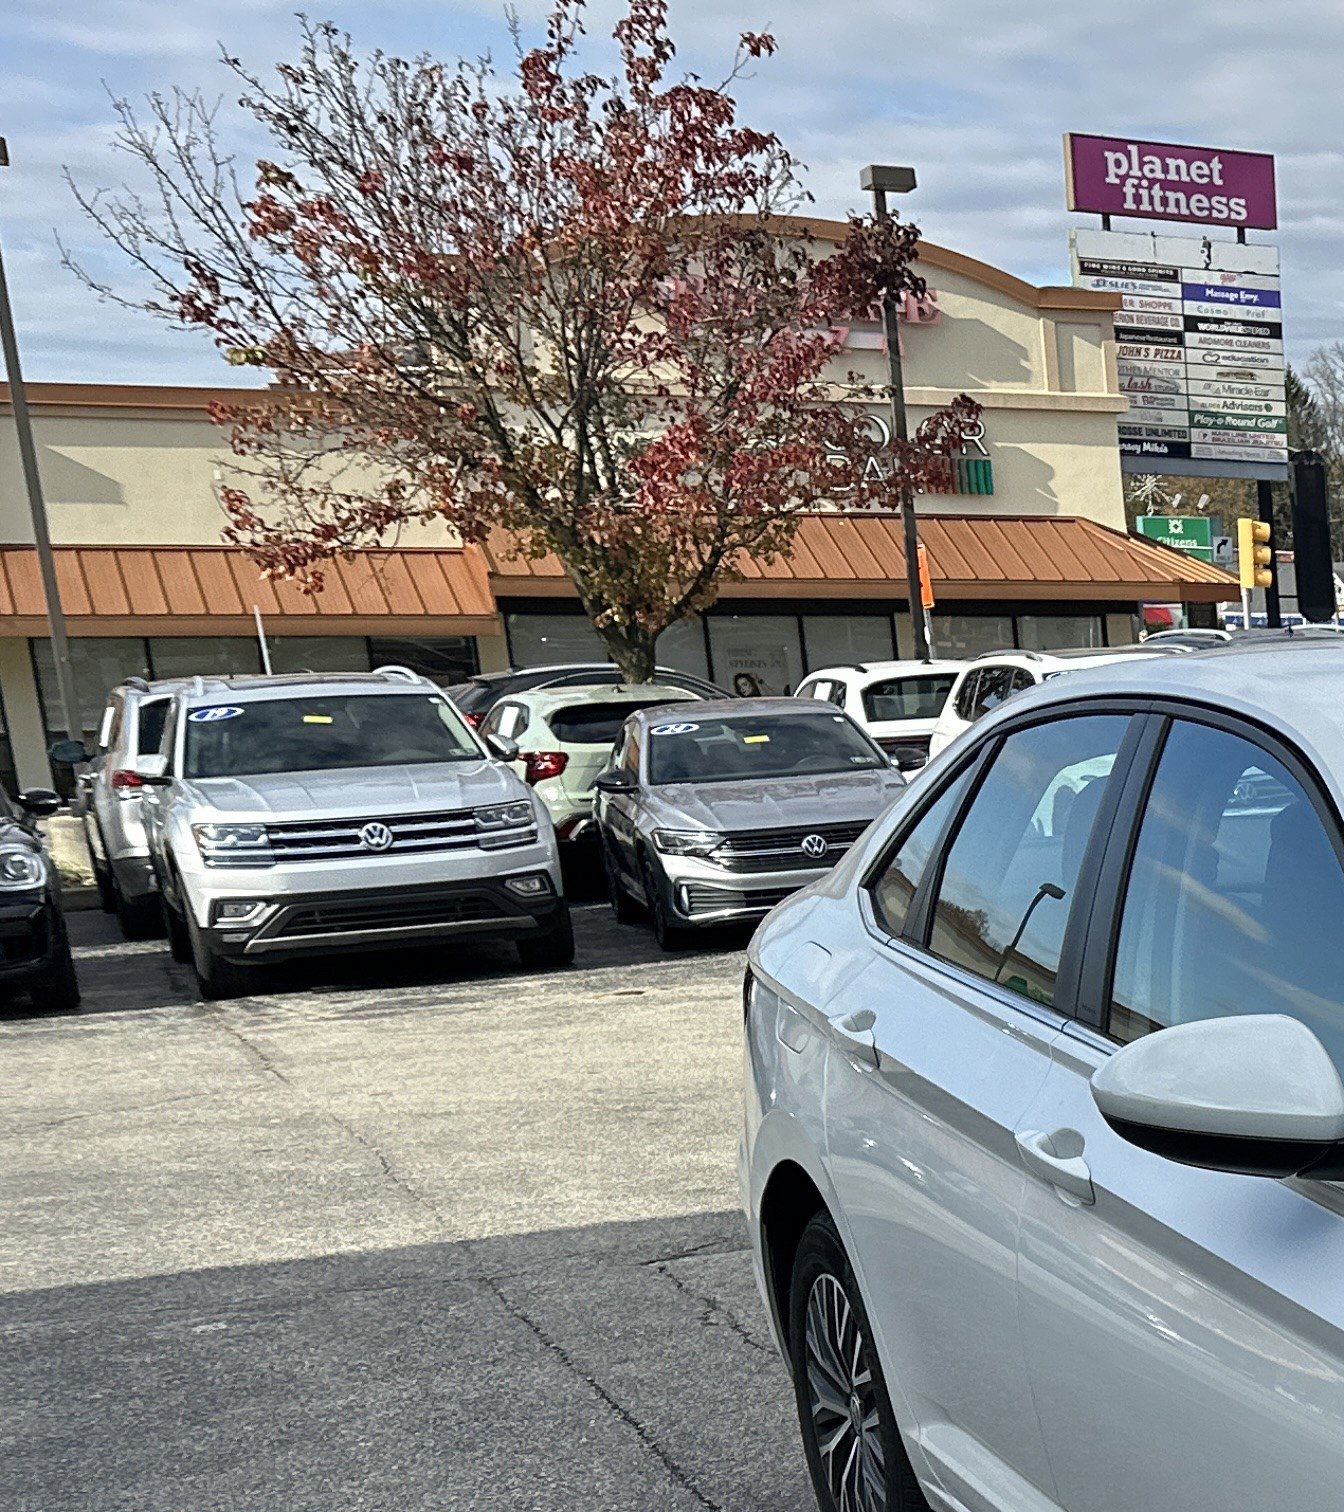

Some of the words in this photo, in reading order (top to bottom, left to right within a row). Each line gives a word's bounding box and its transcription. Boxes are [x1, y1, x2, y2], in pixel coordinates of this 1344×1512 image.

[1103, 144, 1224, 186] planet
[1122, 178, 1248, 221] fitness
[1205, 288, 1239, 301] Massage
[1139, 300, 1173, 311] SHOPPE
[1136, 314, 1169, 327] BEVERAGE
[1198, 337, 1233, 347] ARDMORE
[1235, 340, 1271, 349] CLEANERS
[1153, 348, 1182, 360] PIZZA
[1221, 401, 1263, 412] Advisors
[1257, 418, 1278, 428] Golf
[1145, 428, 1188, 439] UNLIMITED
